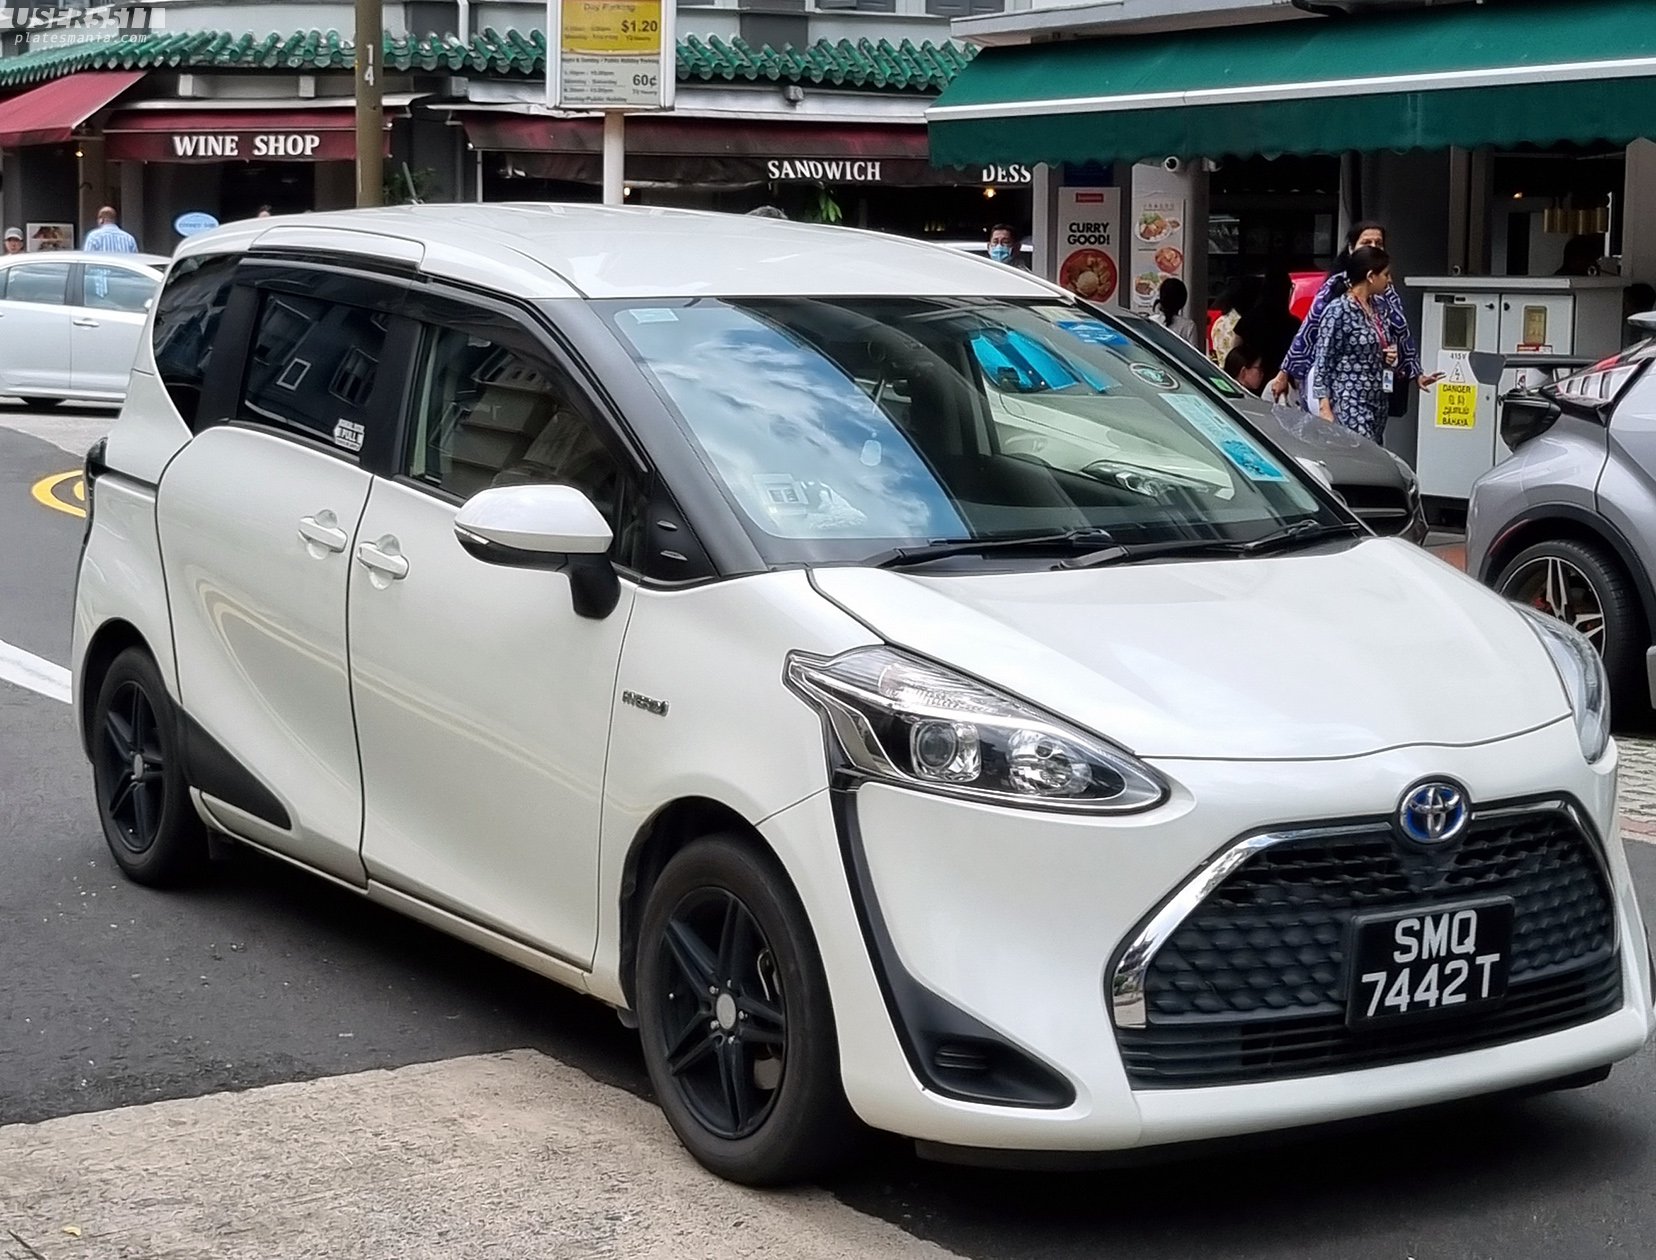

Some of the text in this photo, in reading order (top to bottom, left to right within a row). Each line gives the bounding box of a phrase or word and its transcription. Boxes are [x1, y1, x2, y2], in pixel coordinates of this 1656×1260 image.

[621, 20, 658, 33] $1.20
[632, 74, 657, 88] 60¢
[173, 134, 320, 156] WINE SHOP
[767, 160, 881, 180] SANDWICH
[1069, 222, 1110, 233] CURRY
[1067, 234, 1110, 245] GOOD!
[1442, 384, 1471, 393] DANGER
[1393, 909, 1477, 963] SMQ
[1361, 953, 1500, 1017] 7442T
